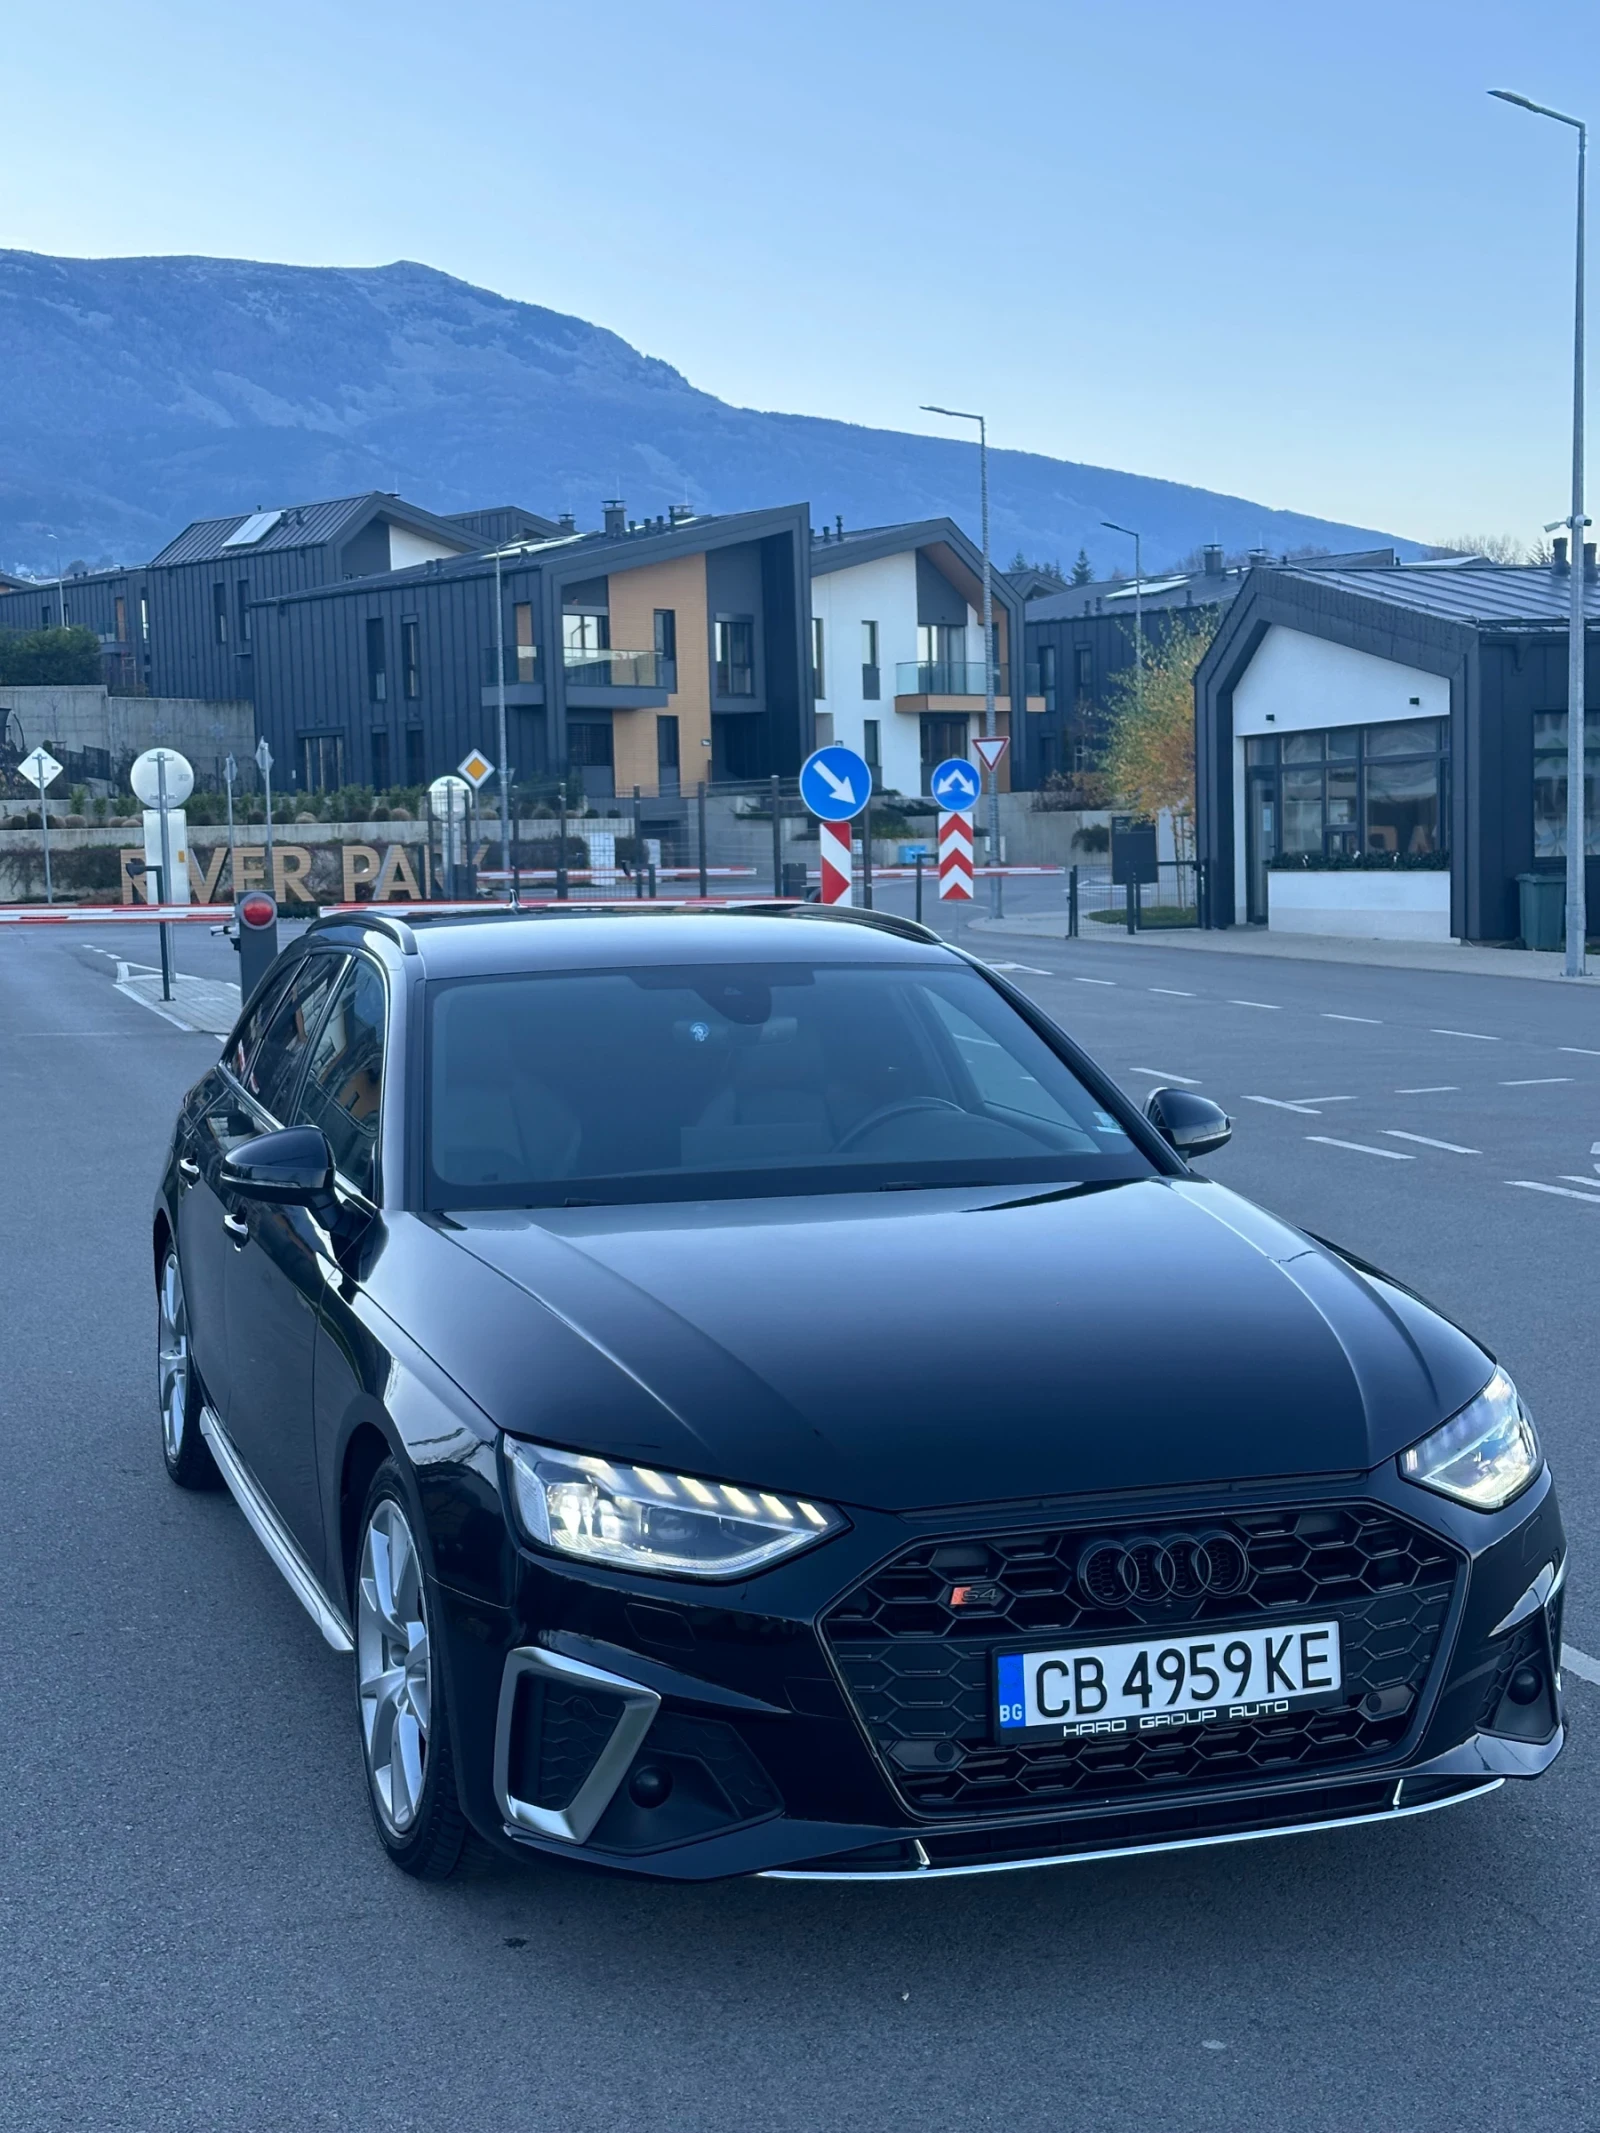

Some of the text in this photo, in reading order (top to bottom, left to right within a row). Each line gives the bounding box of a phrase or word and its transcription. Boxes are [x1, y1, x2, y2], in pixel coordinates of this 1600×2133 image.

[120, 846, 316, 904] RVER
[960, 1587, 998, 1602] S4
[1036, 1630, 1333, 1718] CB 4959 KE
[1000, 1704, 1023, 1722] BG
[1063, 1700, 1289, 1737] HARD GROUP AUTO
